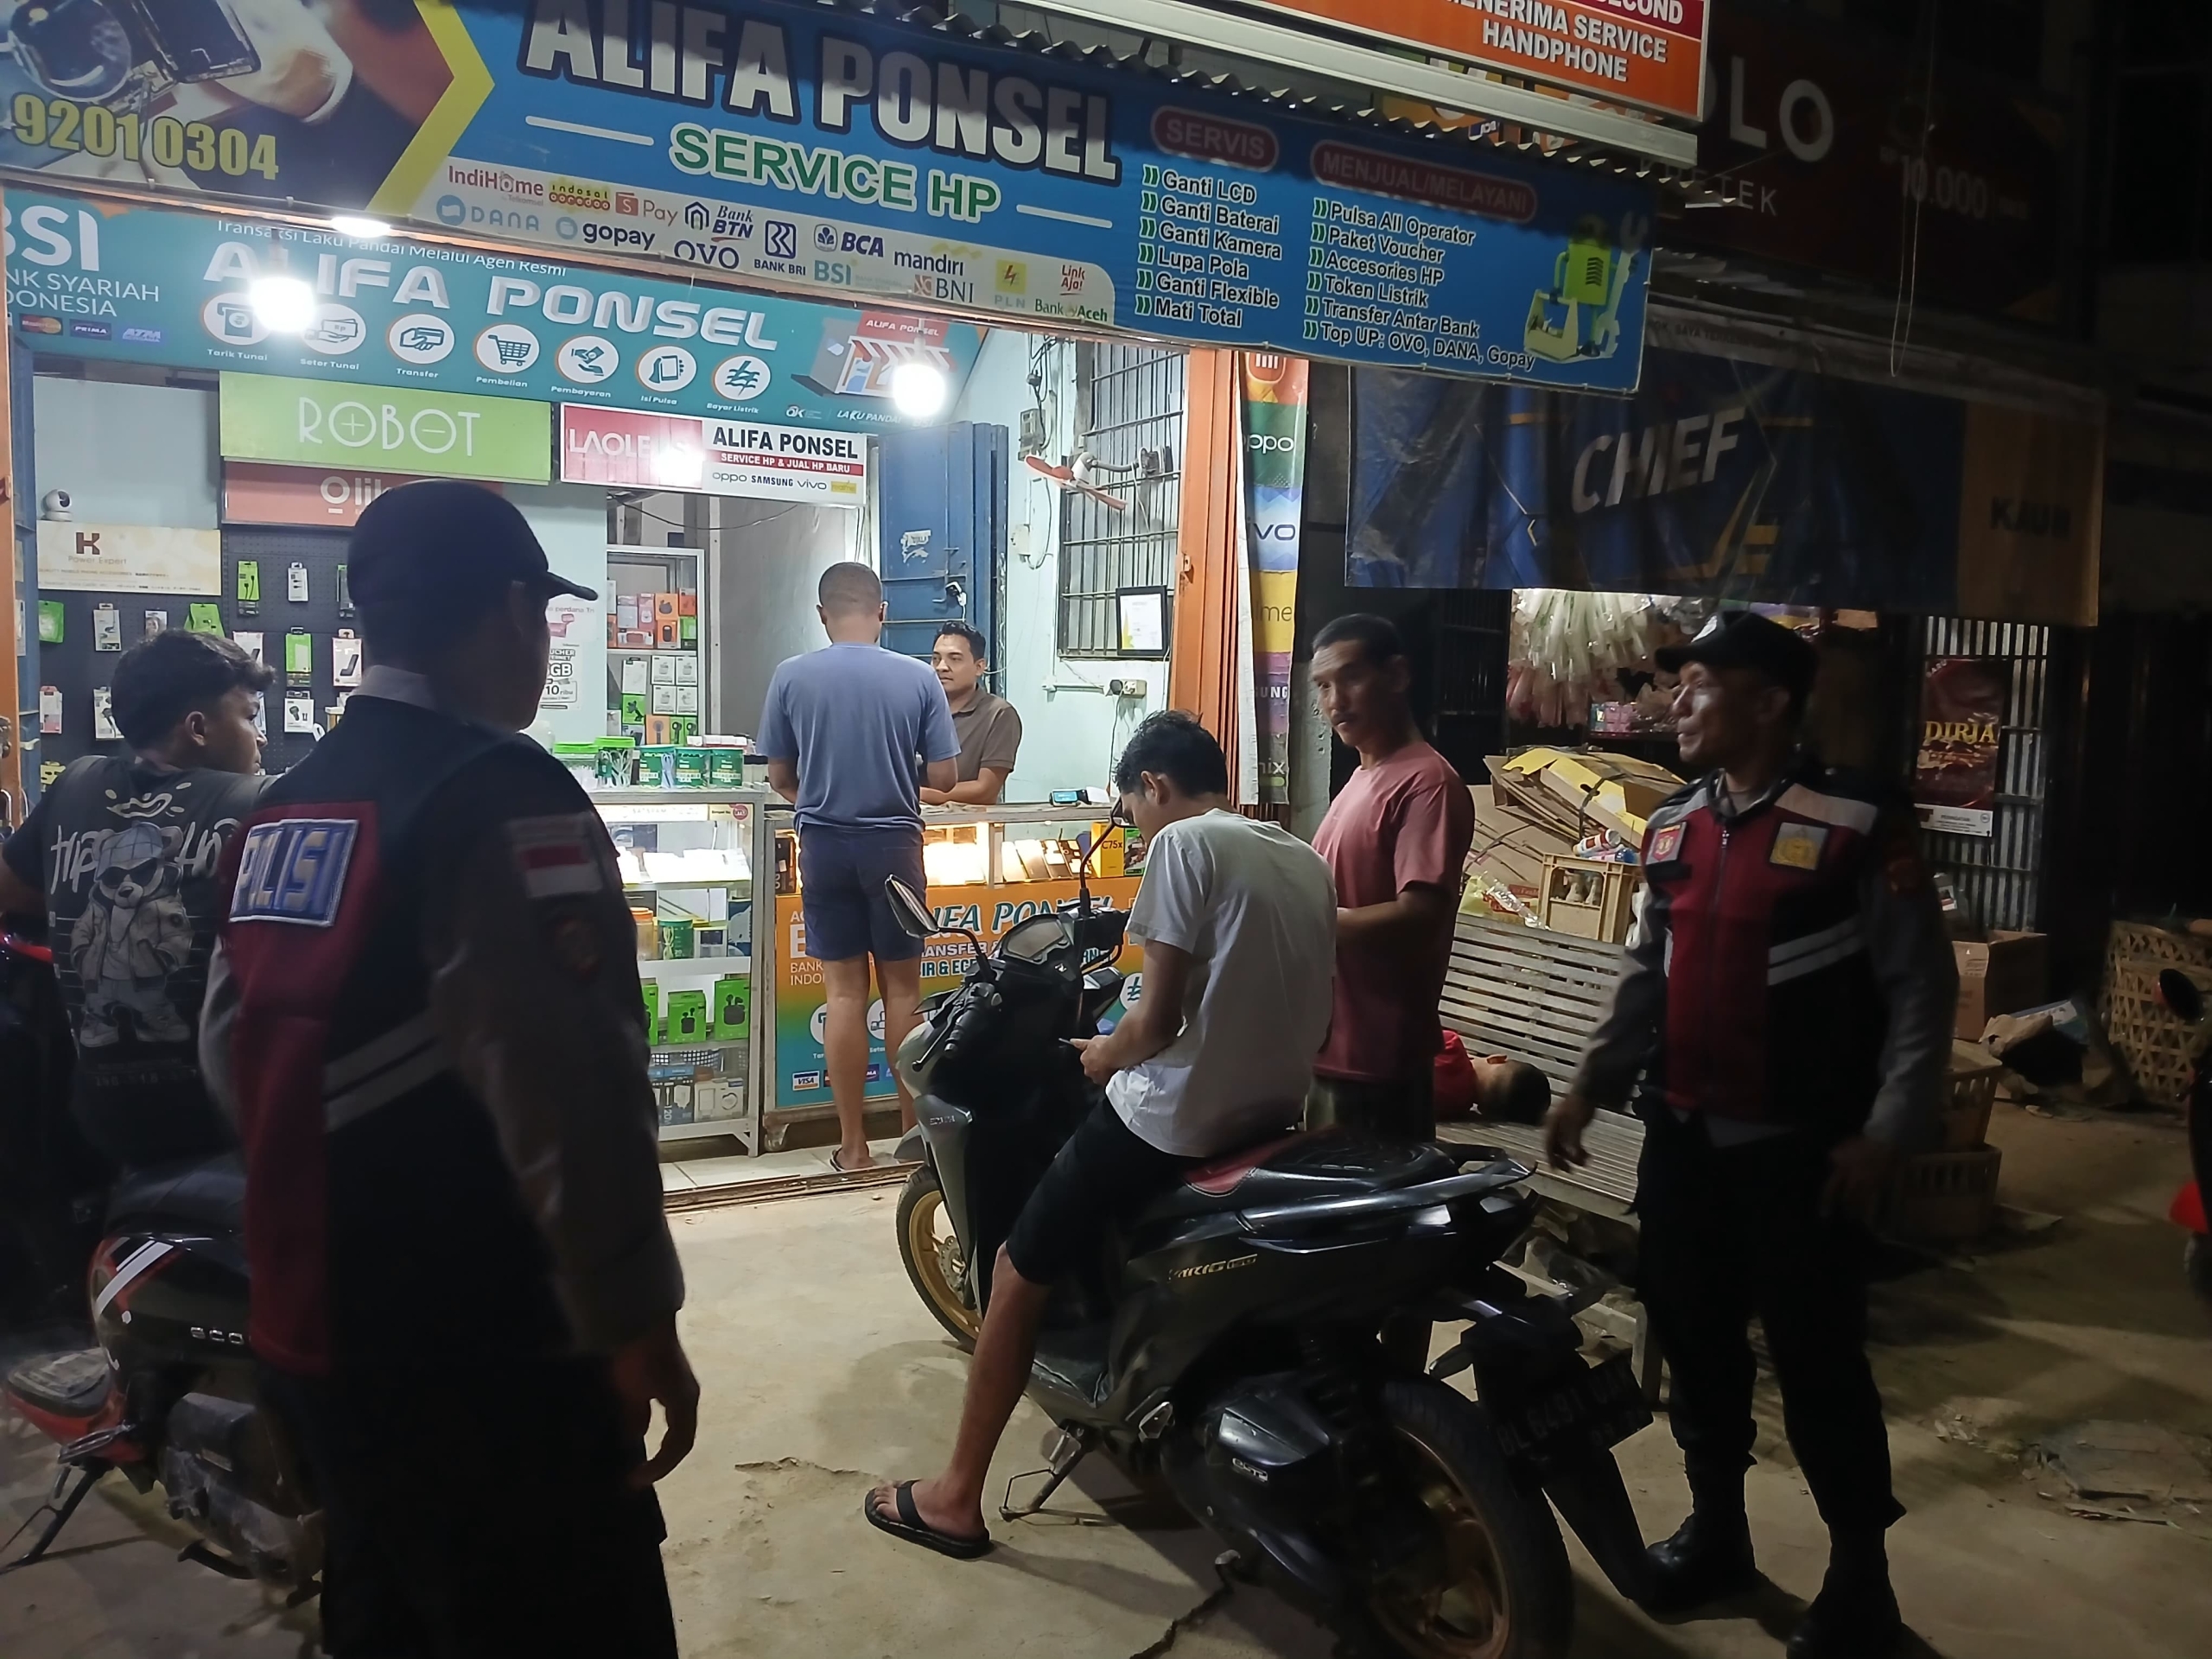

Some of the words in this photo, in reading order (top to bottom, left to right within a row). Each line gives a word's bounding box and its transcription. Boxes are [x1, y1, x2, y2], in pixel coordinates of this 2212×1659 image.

[1483, 19, 1628, 82] HANDPHONE
[1573, 14, 1668, 63] SERVICE
[524, 0, 796, 119] ALIFA
[820, 36, 1118, 181] PONSEL
[1706, 55, 1834, 162] LO
[11, 93, 143, 162] 9201
[152, 116, 279, 181] 0304
[1166, 118, 1266, 161] SERVIS
[448, 165, 544, 197] IndiHome
[672, 125, 917, 210] SERVICE
[930, 172, 1000, 219] HP
[1163, 169, 1212, 197] Ganti
[1217, 181, 1256, 204] LCD
[1321, 149, 1528, 214] MENJUAL/MELAYANI
[549, 192, 611, 211] ooredoo
[643, 200, 678, 226] Pay
[716, 205, 753, 222] Bank
[1161, 196, 1211, 222] Ganti
[1215, 206, 1280, 234] Baterai
[471, 205, 540, 232] DANA
[712, 219, 754, 238] BTN
[1330, 201, 1378, 229] Pulsa
[1381, 212, 1403, 234] All
[1406, 218, 1477, 246] Operator
[582, 222, 656, 251] gopay
[841, 231, 885, 257] BCA
[1160, 222, 1209, 247] Ganti
[1214, 231, 1282, 260] Kamera
[1328, 226, 1376, 252] Paket
[1378, 235, 1445, 264] Voucher
[303, 231, 344, 248] Laku
[349, 236, 405, 255] Pandai
[409, 245, 471, 264] Melalui
[473, 254, 517, 272] Agen
[519, 261, 568, 277] Resmi
[674, 239, 740, 270] OVO
[754, 258, 785, 273] BANK
[788, 263, 806, 276] BRI
[893, 251, 964, 276] mandiri
[1158, 246, 1204, 272] Lupa
[1209, 256, 1249, 279] Pola
[814, 259, 852, 286] BSI
[1061, 264, 1086, 280] Link
[1325, 251, 1417, 283] Accesories
[1421, 267, 1445, 288] HP
[47, 273, 159, 302] SYARIAH
[203, 241, 451, 309] AIFA
[486, 276, 779, 353] PONSEL
[936, 277, 975, 303] BNI
[994, 294, 1027, 308] PLN
[1156, 273, 1205, 297] Ganti
[1211, 282, 1280, 308] Flexible
[1325, 274, 1375, 301] Token
[1377, 283, 1429, 309] Listrik
[1034, 298, 1065, 316] Bank
[1077, 305, 1108, 322] Aceh
[1154, 297, 1194, 321] Mati
[1198, 304, 1243, 327] Total
[1322, 299, 1392, 327] Transfer
[1394, 309, 1437, 334] Antar
[1440, 317, 1481, 340] Bank
[866, 320, 896, 330] ALIFA
[207, 348, 235, 360] Tarik
[238, 351, 268, 361] Tunai
[1320, 321, 1352, 346] Top
[1356, 327, 1385, 349] UP:
[1389, 333, 1430, 357] OVO,
[1434, 340, 1484, 364] DANA,
[1488, 344, 1536, 372] Gopay
[300, 358, 329, 369] Setor
[331, 360, 359, 371] Tunai
[396, 367, 439, 378] Transfer
[475, 376, 528, 389] Pembelian
[550, 385, 611, 398] Pembayaran
[640, 394, 652, 404] Isi
[653, 397, 677, 405] Pulsa
[706, 403, 733, 413] Bayar
[734, 404, 760, 415] Listrik
[298, 396, 481, 457] ROBOT
[712, 426, 773, 451] ALIFA
[779, 432, 859, 460] PONSEL
[721, 453, 761, 465] SERVICE
[762, 456, 775, 467] HP
[777, 458, 785, 467] &
[787, 459, 810, 469] JUAL
[811, 461, 824, 471] HP
[827, 462, 850, 474] BARU
[1571, 406, 1746, 514] CHIEF
[712, 472, 747, 482] oppo
[751, 475, 794, 487] SAMSUNG
[797, 479, 827, 490] vivo
[67, 555, 95, 564] Power
[99, 557, 127, 566] Expert
[790, 974, 824, 986] INDO
[938, 959, 950, 975] &
[798, 1077, 815, 1085] VISA
